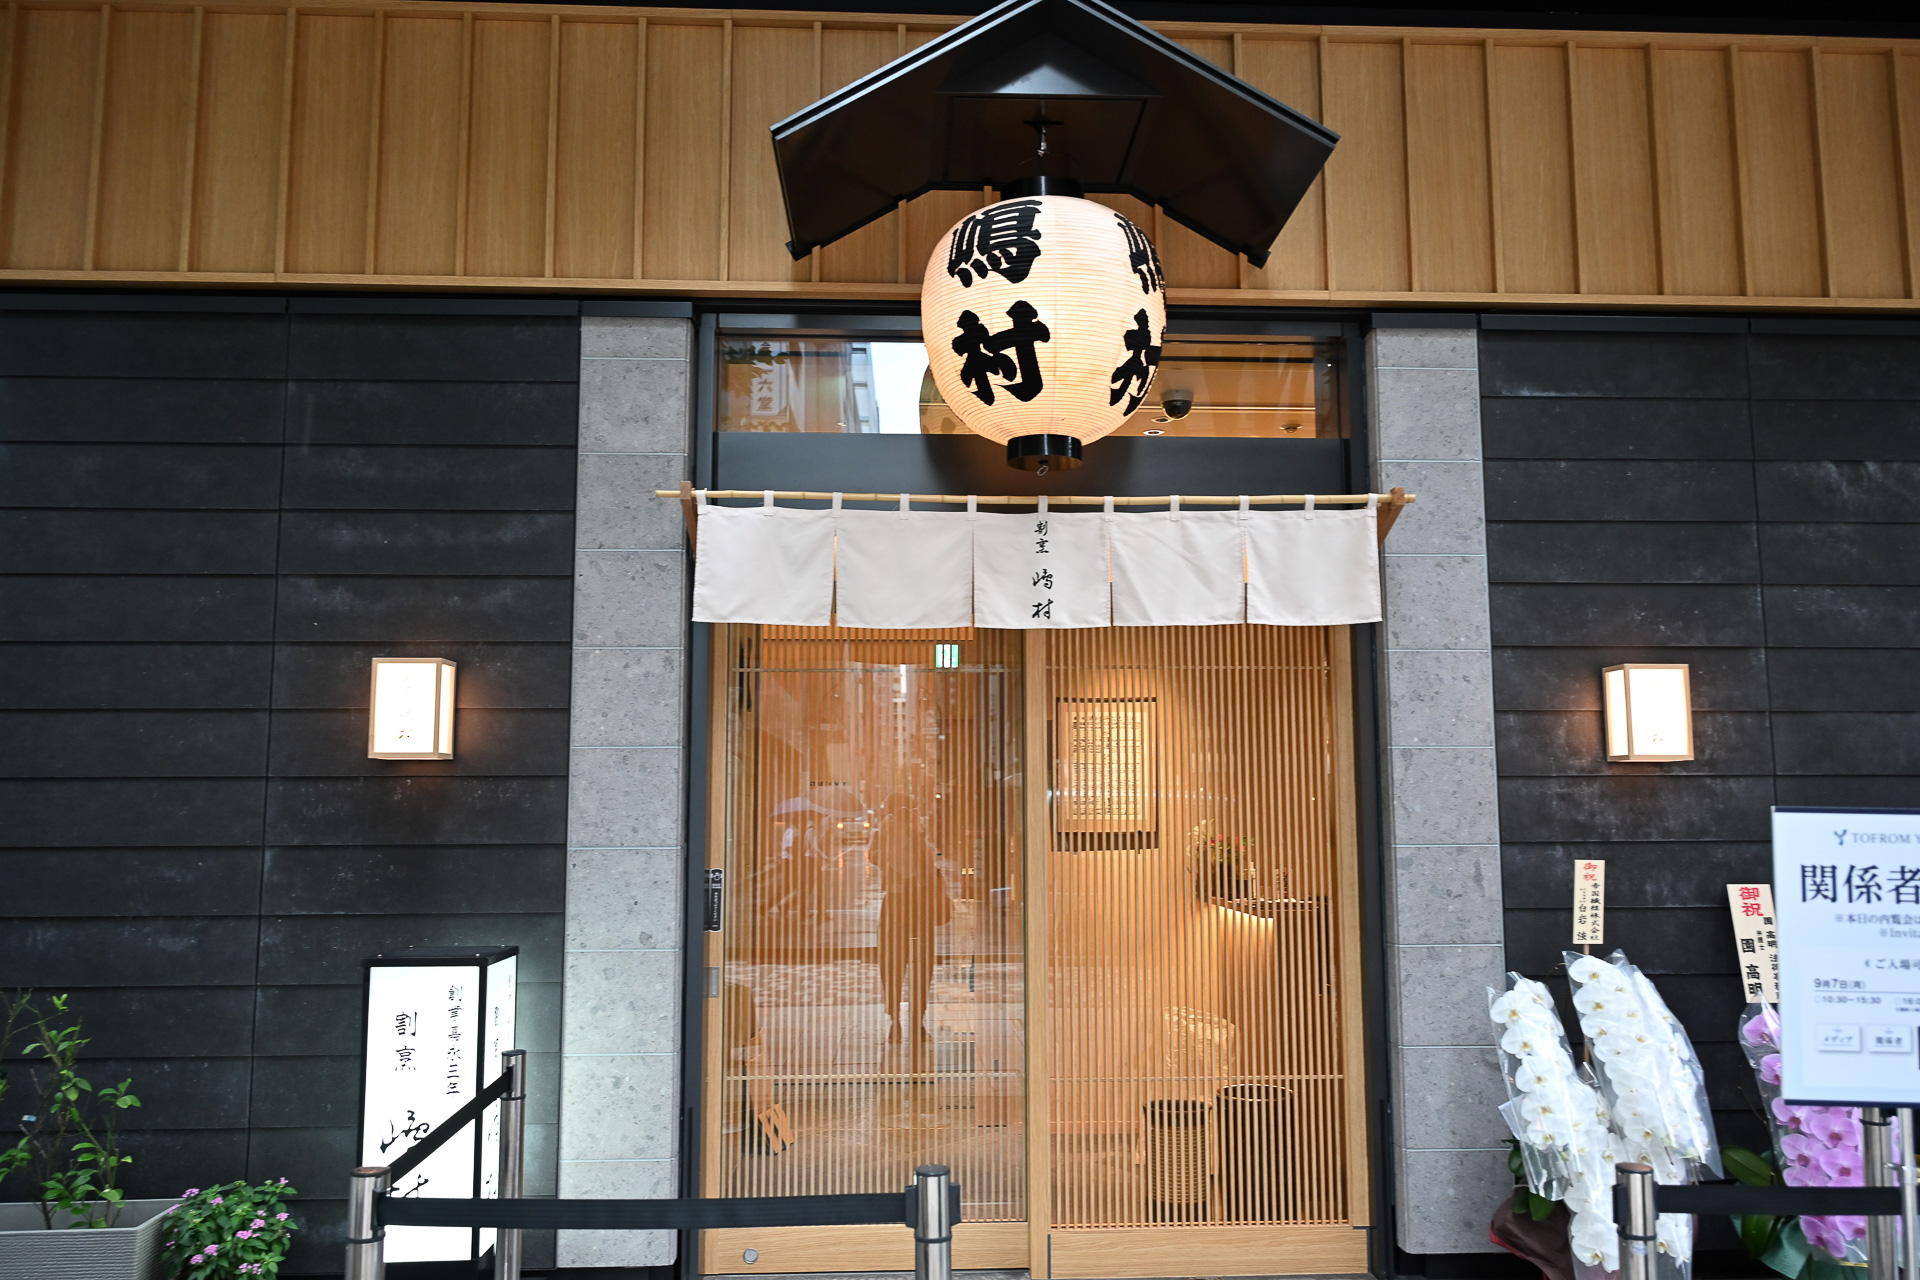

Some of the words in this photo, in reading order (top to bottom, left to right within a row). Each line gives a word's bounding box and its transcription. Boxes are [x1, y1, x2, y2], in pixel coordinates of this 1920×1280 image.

[1851, 832, 1911, 844] TOFROM
[1801, 864, 1920, 904] 関係者
[1738, 886, 1765, 917] 御祝
